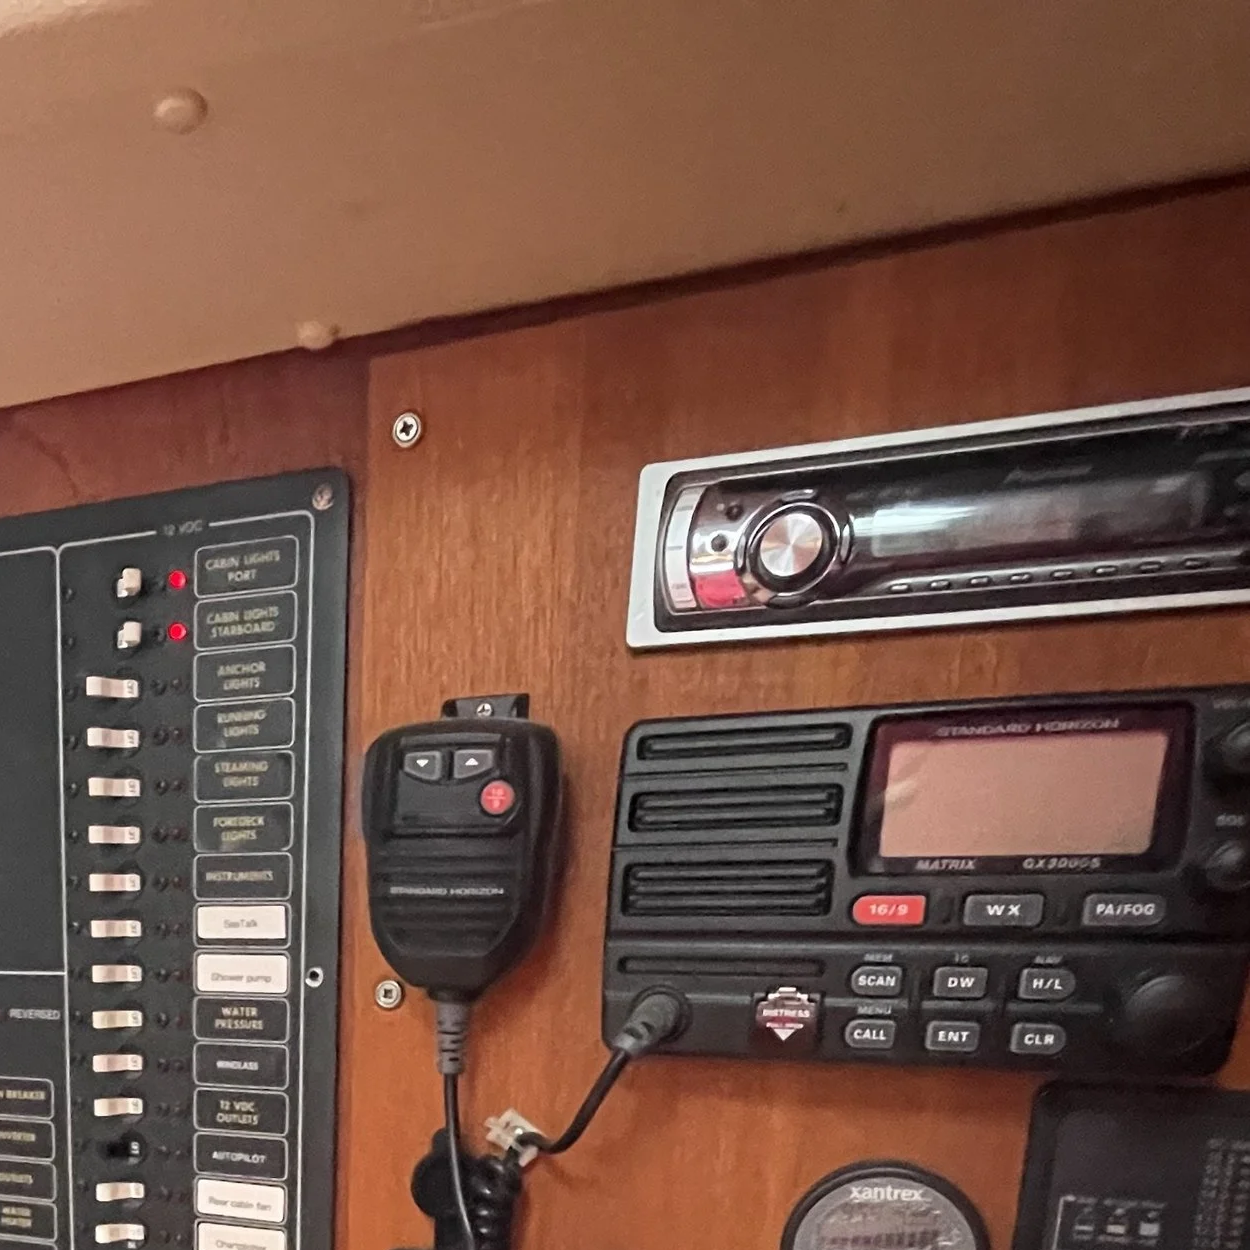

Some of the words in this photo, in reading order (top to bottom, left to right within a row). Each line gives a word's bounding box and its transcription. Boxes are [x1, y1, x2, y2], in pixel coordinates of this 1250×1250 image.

[205, 555, 240, 571] CABIN
[243, 549, 281, 566] LIGHTS
[226, 568, 258, 582] PORT
[206, 609, 239, 625] CABIN
[243, 605, 280, 621] LIGHTS
[210, 620, 276, 638] STARBOARD
[216, 660, 267, 677] ANCHOR
[223, 676, 261, 691] LIGHTS
[216, 708, 268, 724] RUNNING
[223, 723, 260, 738] LIGHTS
[935, 722, 1031, 738] STANDARD
[1034, 717, 1121, 733] HORIZON
[214, 760, 269, 774] STEAMING
[222, 775, 259, 788] LIGHTS
[220, 829, 257, 841] LIGHTS
[914, 857, 978, 872] MATRIX
[390, 886, 448, 896] STANDARD
[449, 886, 505, 896] HORIZON
[868, 903, 910, 917] 16/9
[985, 903, 1022, 917] WX
[1095, 902, 1156, 917] PA/FOG
[246, 975, 272, 984] pump
[857, 975, 897, 987] SCAN
[946, 977, 976, 989] DW
[1031, 978, 1064, 990] H/L
[8, 1007, 61, 1021] REVERSED
[221, 1006, 259, 1018] WATER
[762, 1008, 810, 1018] DISTRESS
[856, 1005, 893, 1015] MENU
[214, 1018, 264, 1031] PRESSURE
[853, 1029, 887, 1041] CALL
[937, 1031, 971, 1042] ENT
[1023, 1033, 1055, 1045] CLR
[5, 1089, 46, 1101] BREAKER
[219, 1099, 231, 1111] 12
[233, 1100, 255, 1113] VDC
[216, 1112, 259, 1125] OUTLETS
[212, 1150, 268, 1164] AUTOPILOT
[849, 1184, 926, 1202] xantrex
